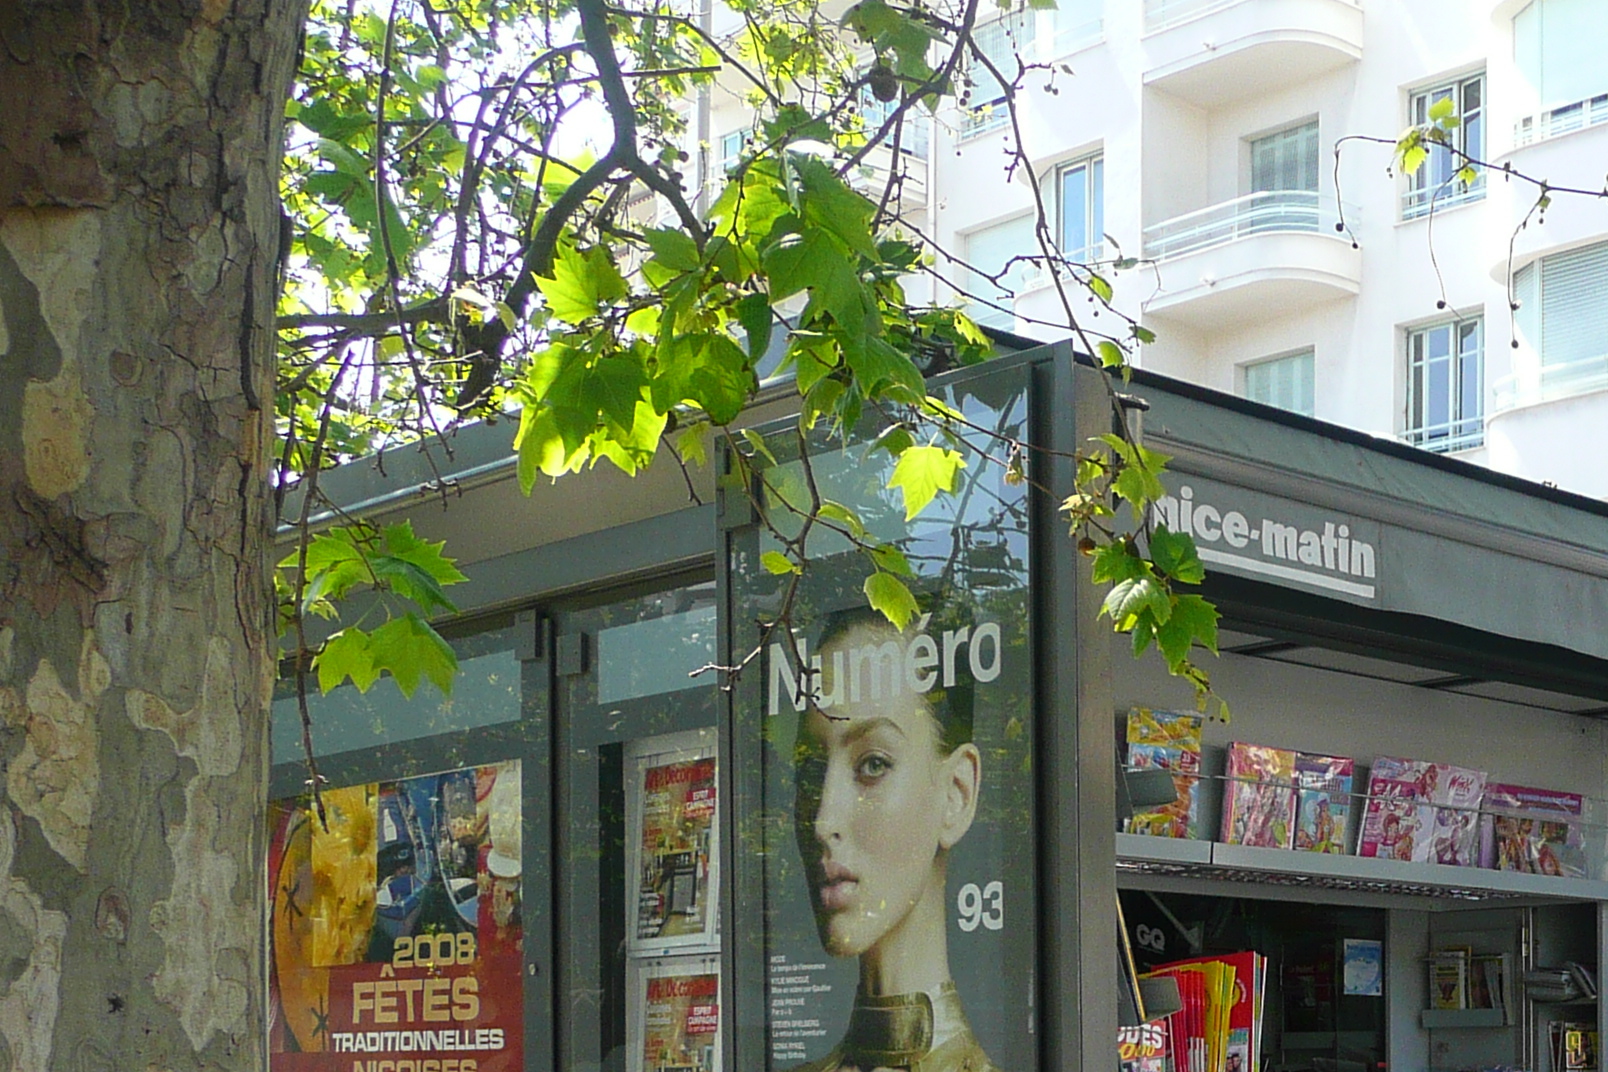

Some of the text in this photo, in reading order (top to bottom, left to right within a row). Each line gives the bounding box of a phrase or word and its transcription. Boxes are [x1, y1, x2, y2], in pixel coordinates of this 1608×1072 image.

[1153, 485, 1376, 579] nice-matin
[768, 612, 1000, 716] Numéro
[957, 881, 1004, 932] 93
[392, 931, 476, 969] 2008
[1136, 923, 1166, 951] GQ
[352, 964, 480, 1024] FÊTES
[332, 1027, 505, 1054] TRADITIONNELLES
